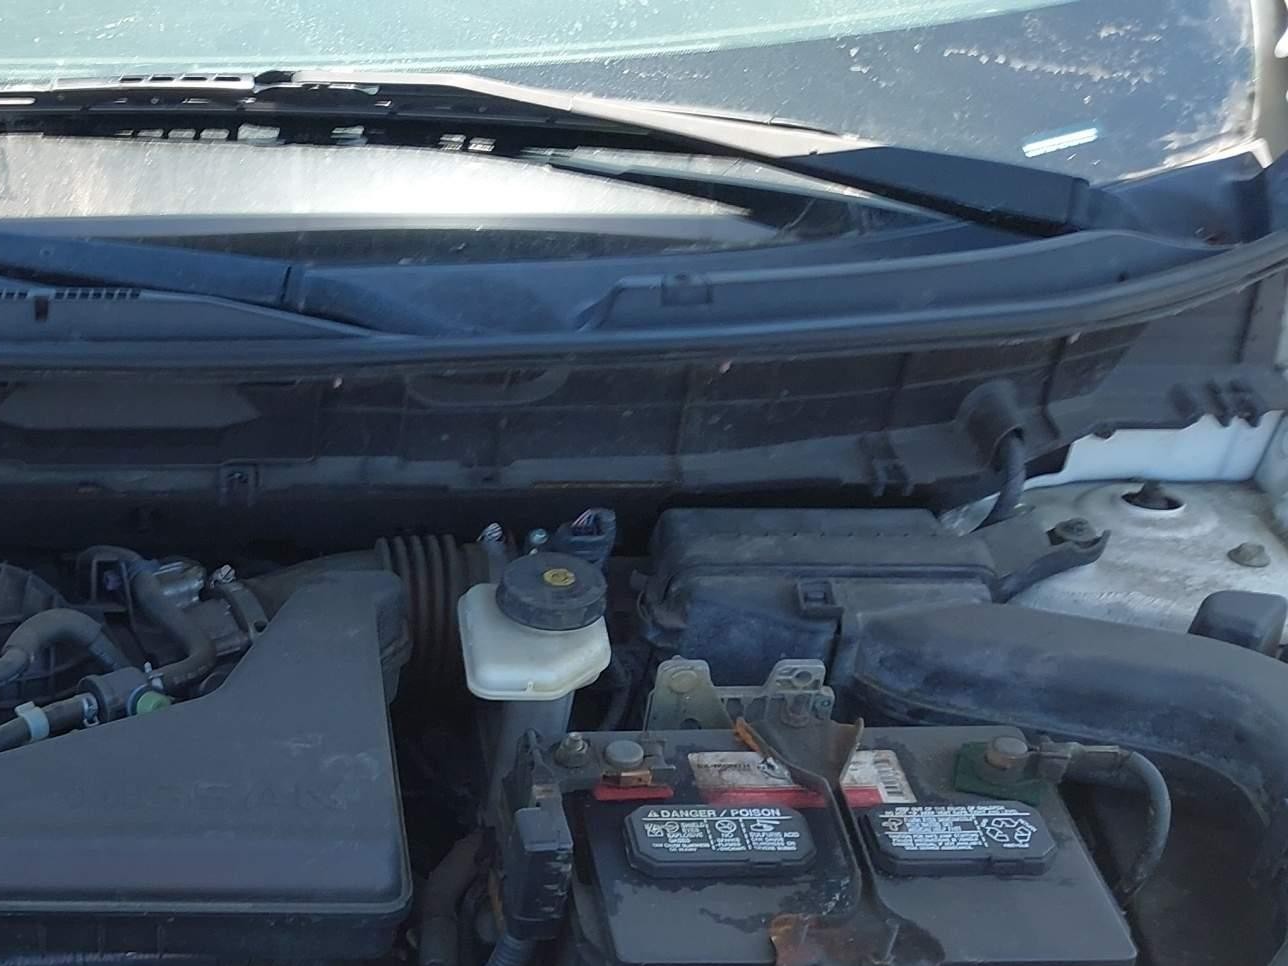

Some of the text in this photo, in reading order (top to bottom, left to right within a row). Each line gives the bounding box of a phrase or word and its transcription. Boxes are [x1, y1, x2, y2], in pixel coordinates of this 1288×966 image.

[660, 808, 782, 818] DANGER / POISON
